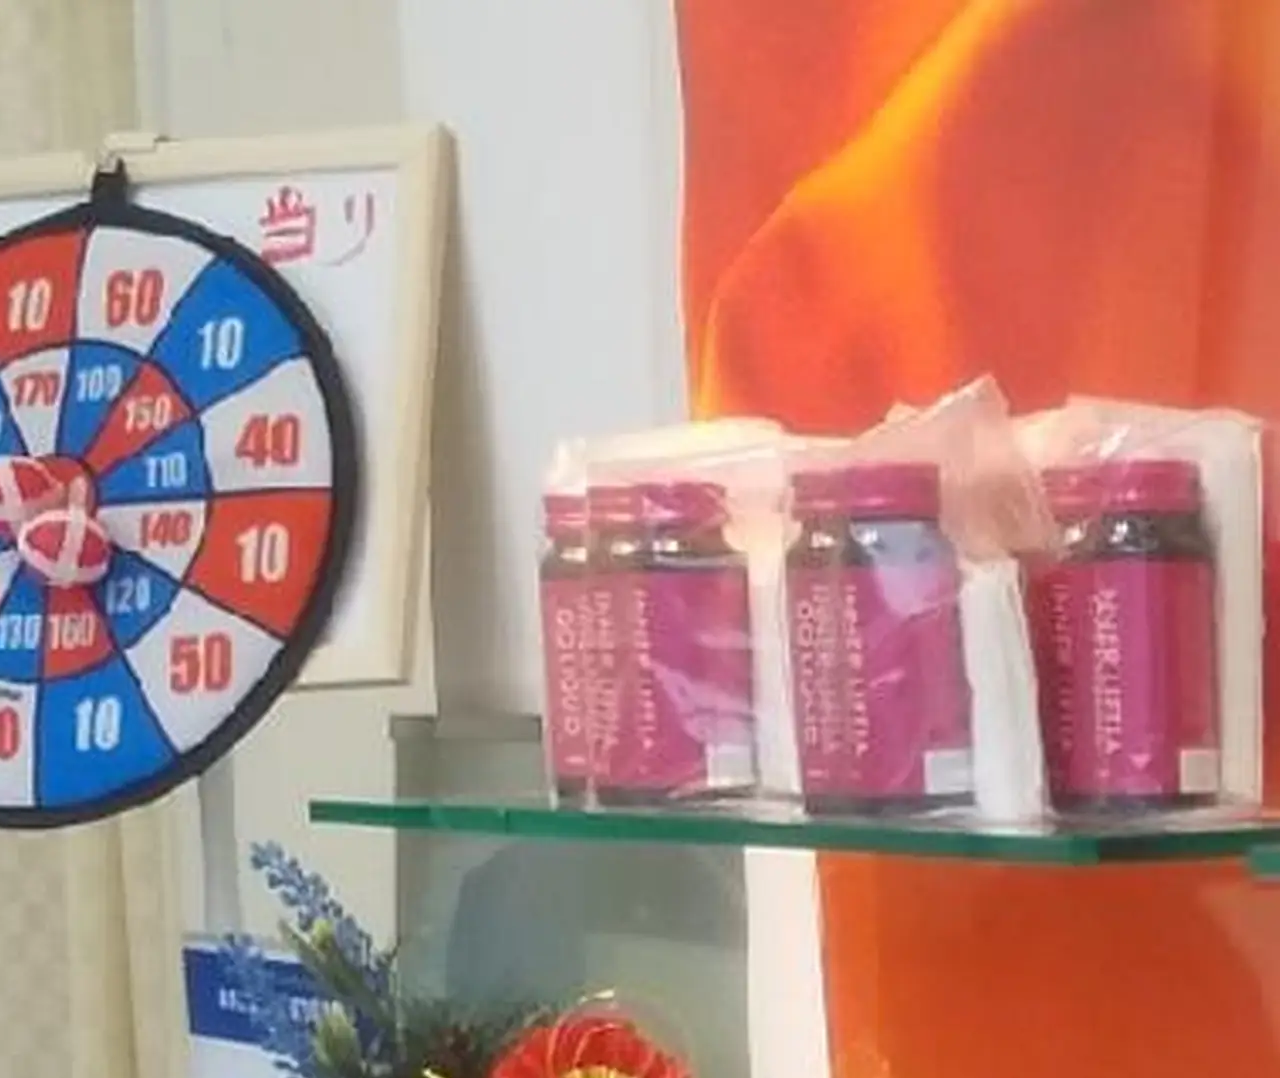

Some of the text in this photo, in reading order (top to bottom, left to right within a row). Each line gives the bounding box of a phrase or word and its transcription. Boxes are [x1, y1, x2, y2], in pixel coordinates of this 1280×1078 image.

[8, 279, 52, 332] 10
[105, 271, 163, 327] 60
[199, 317, 244, 369] 10
[77, 366, 120, 400] 100
[236, 416, 300, 467] 40
[146, 453, 185, 487] 110
[140, 511, 190, 548] 140
[238, 526, 287, 582] 10
[170, 634, 232, 692] 50
[76, 699, 121, 750] 10
